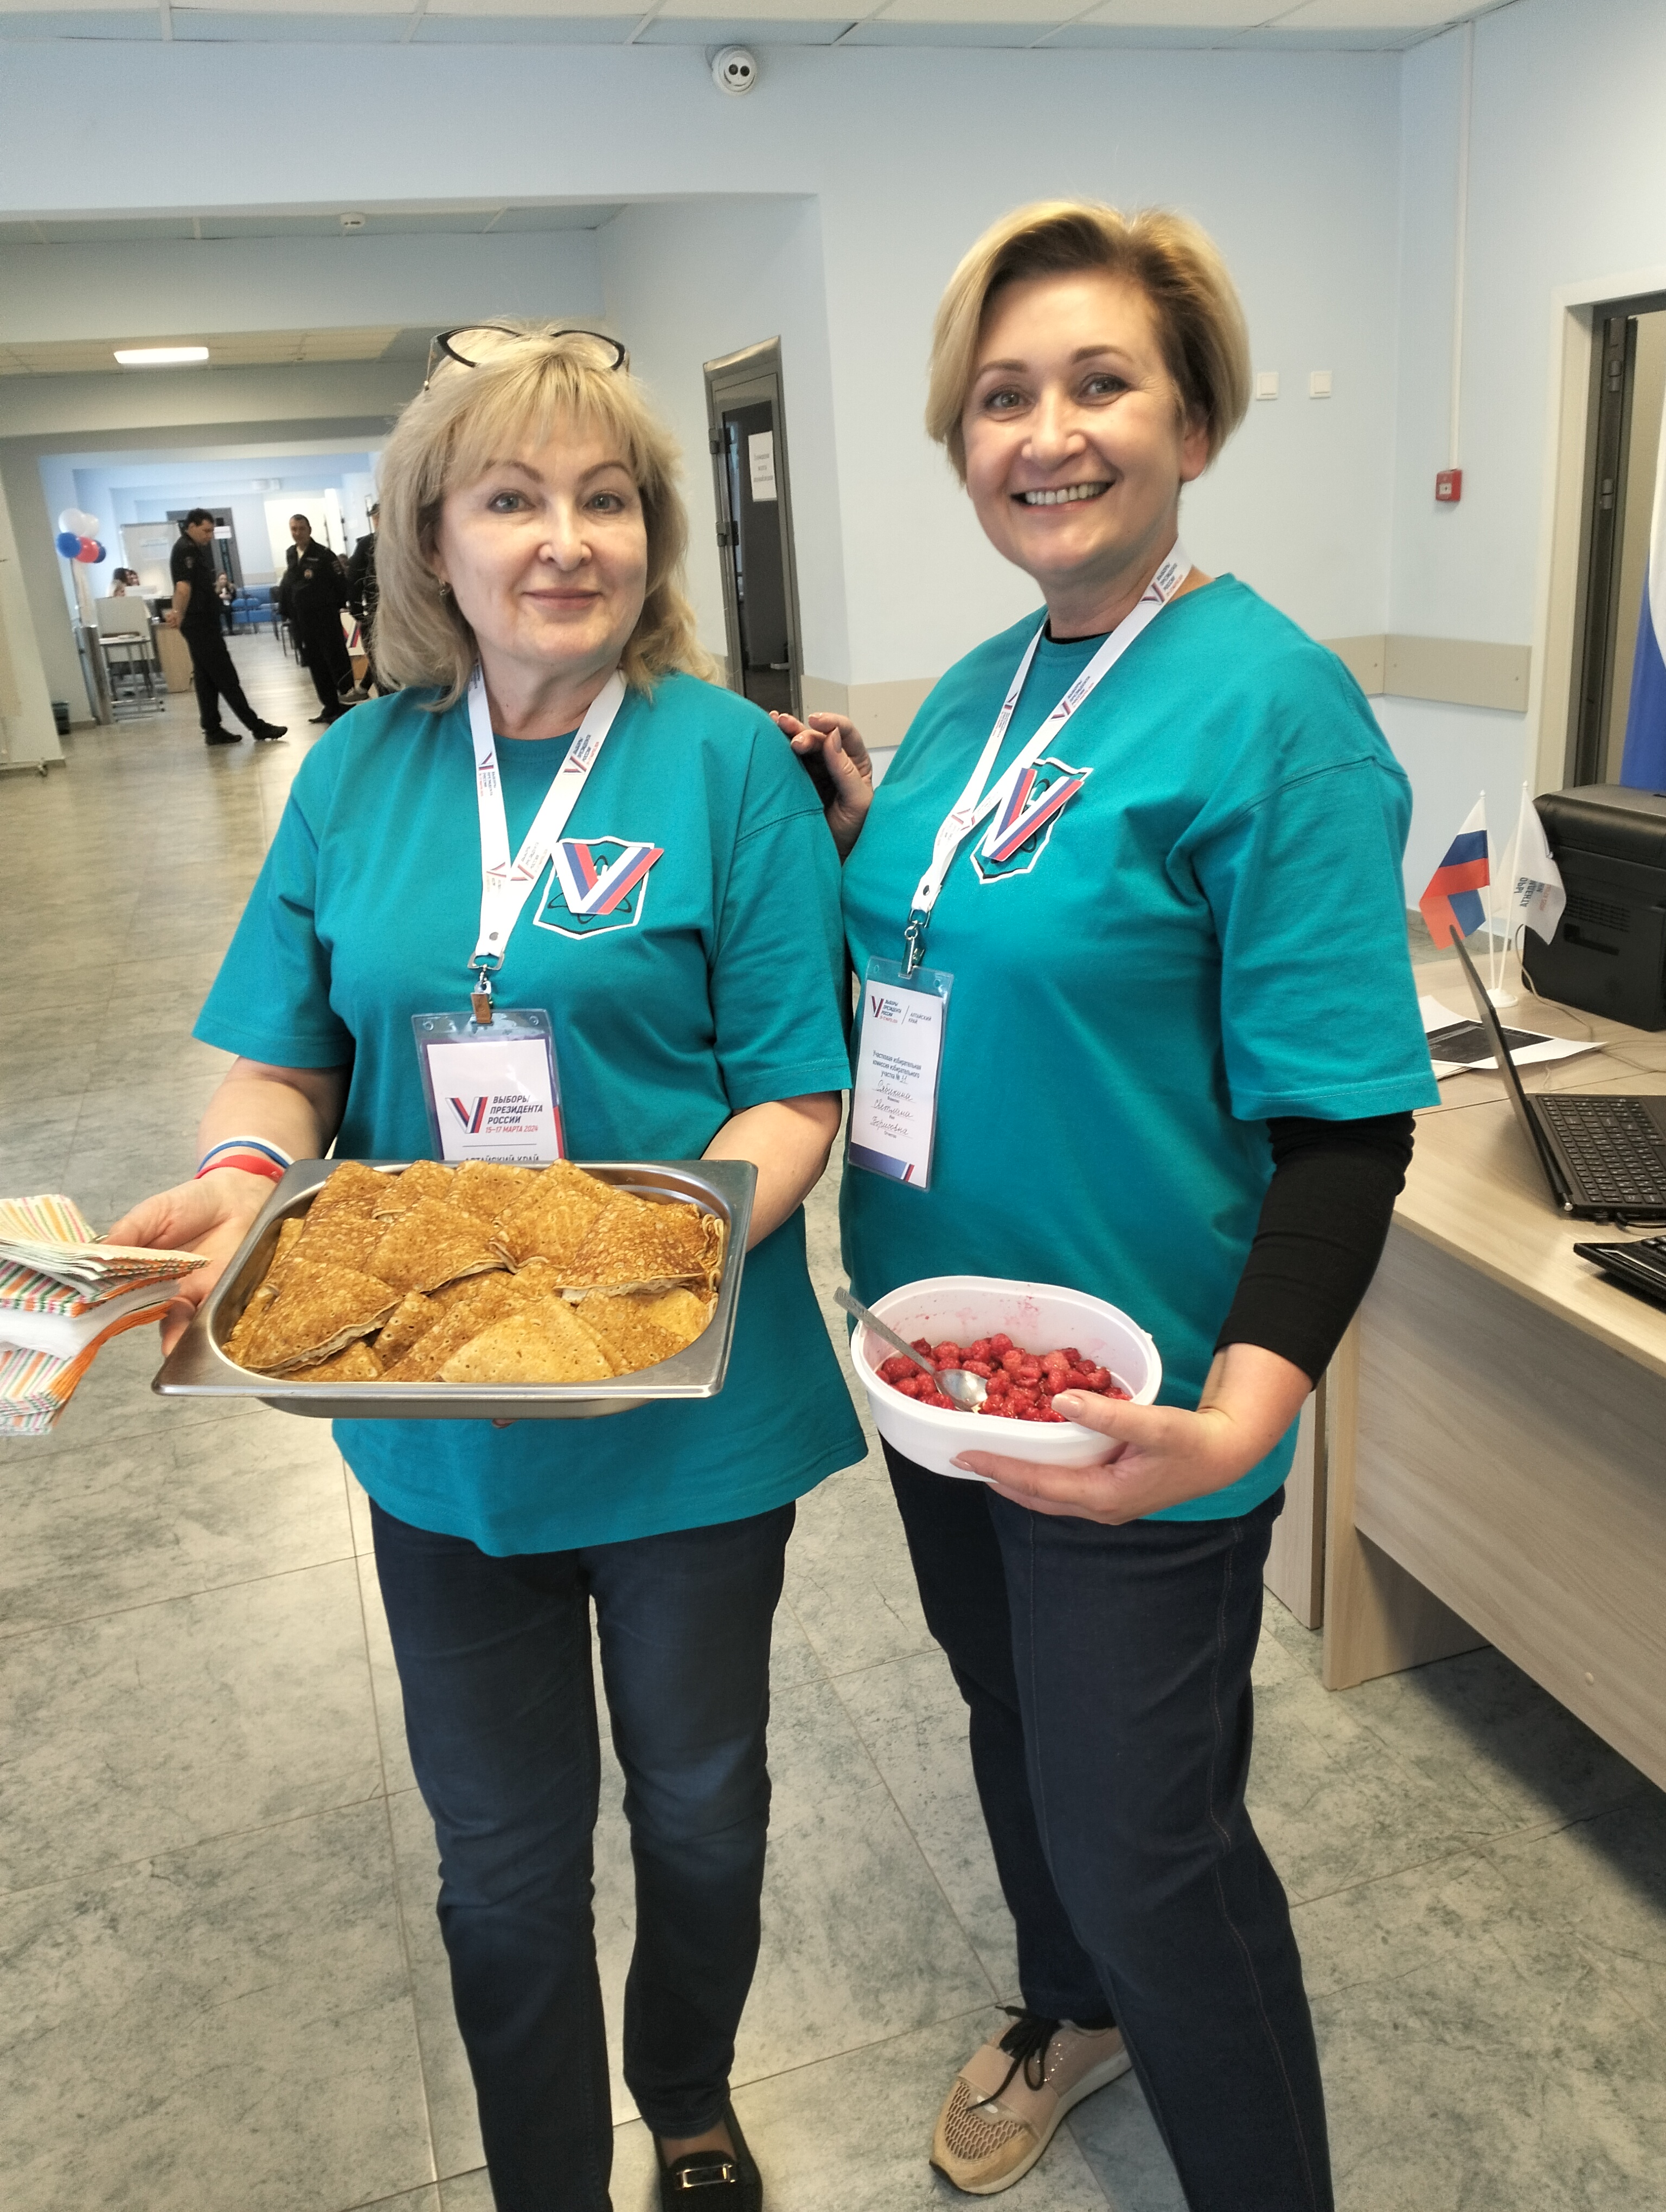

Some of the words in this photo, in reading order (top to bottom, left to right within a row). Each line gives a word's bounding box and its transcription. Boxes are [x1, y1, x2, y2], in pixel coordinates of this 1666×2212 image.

[493, 1095, 530, 1104] ВЫБОРЫ
[490, 1105, 543, 1114] ПРЕЗИДЕНТА
[488, 1116, 521, 1124] РОССИИ
